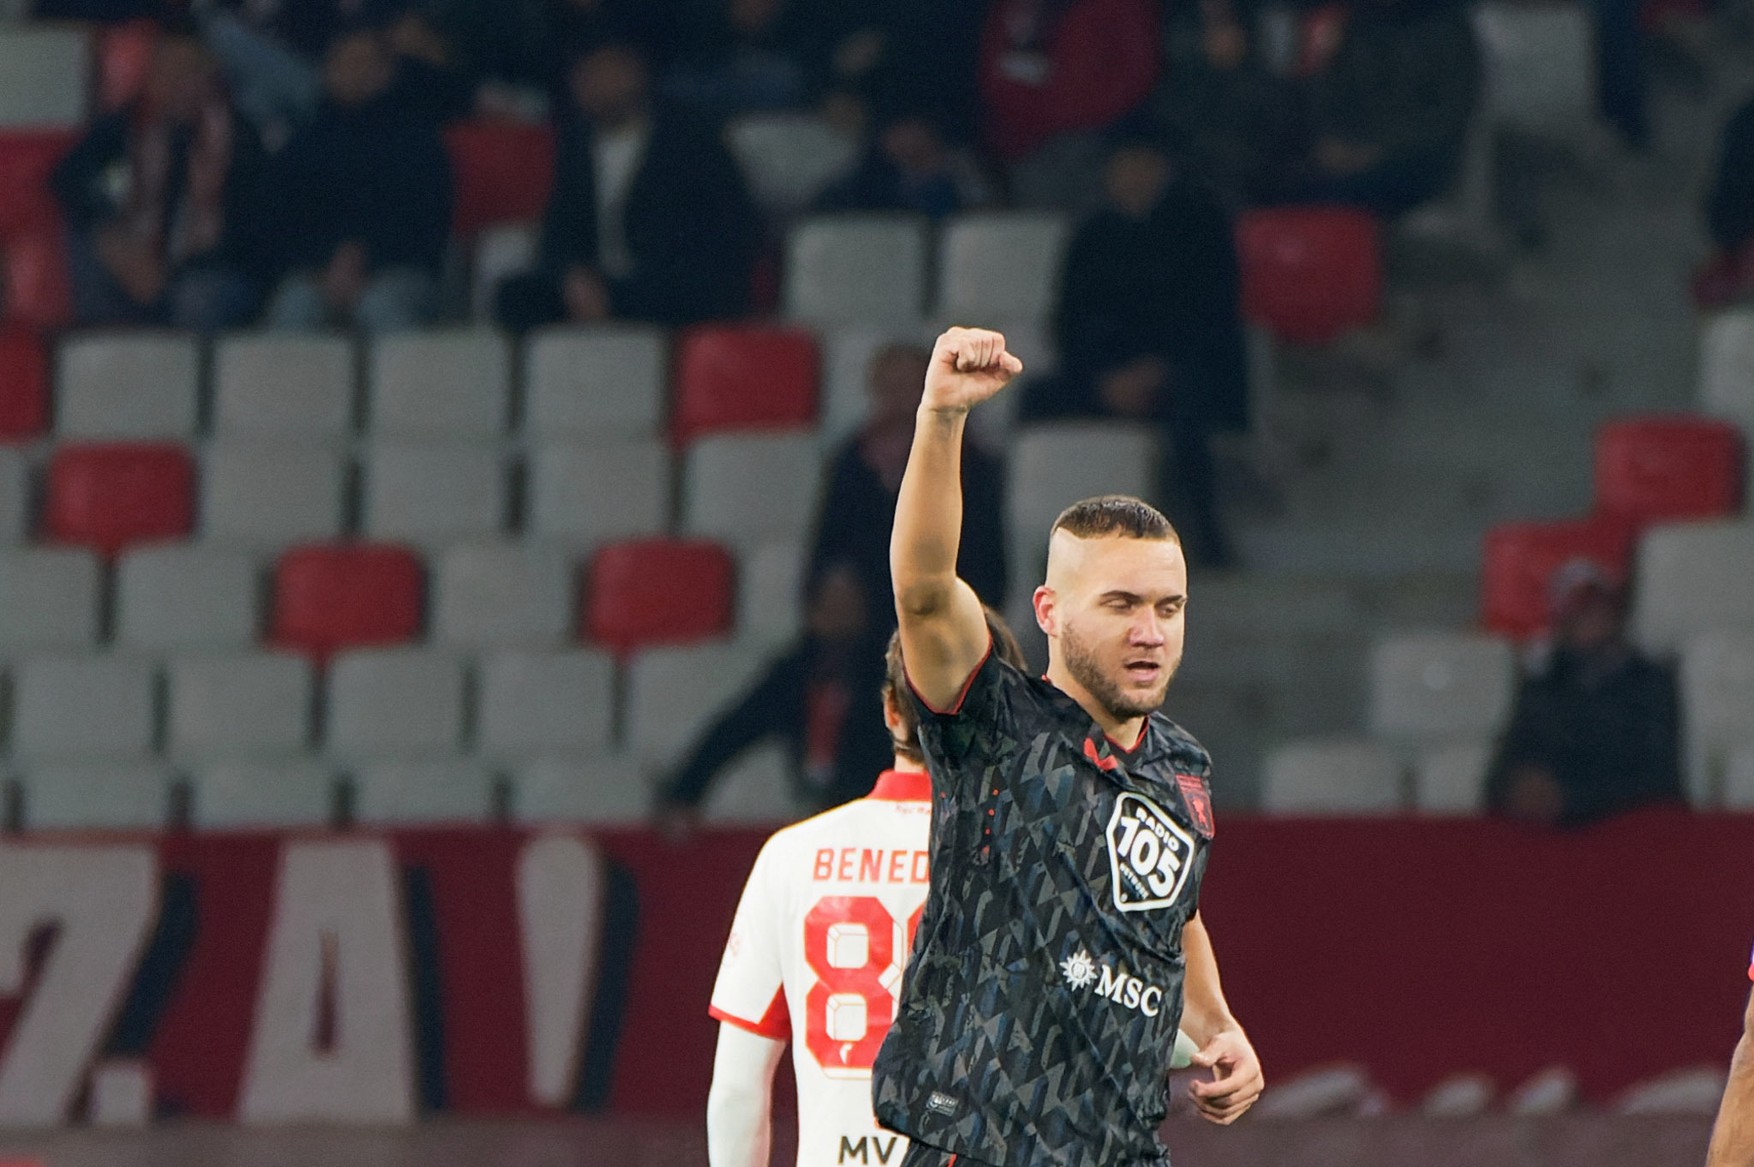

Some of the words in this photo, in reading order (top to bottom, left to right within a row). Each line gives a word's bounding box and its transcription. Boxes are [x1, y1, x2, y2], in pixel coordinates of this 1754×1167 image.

[1135, 806, 1180, 852] RADIO
[812, 847, 931, 884] BENED
[1117, 816, 1181, 898] 105
[803, 895, 926, 1071] 8
[1094, 964, 1162, 1017] MSC
[837, 1135, 898, 1166] MV
